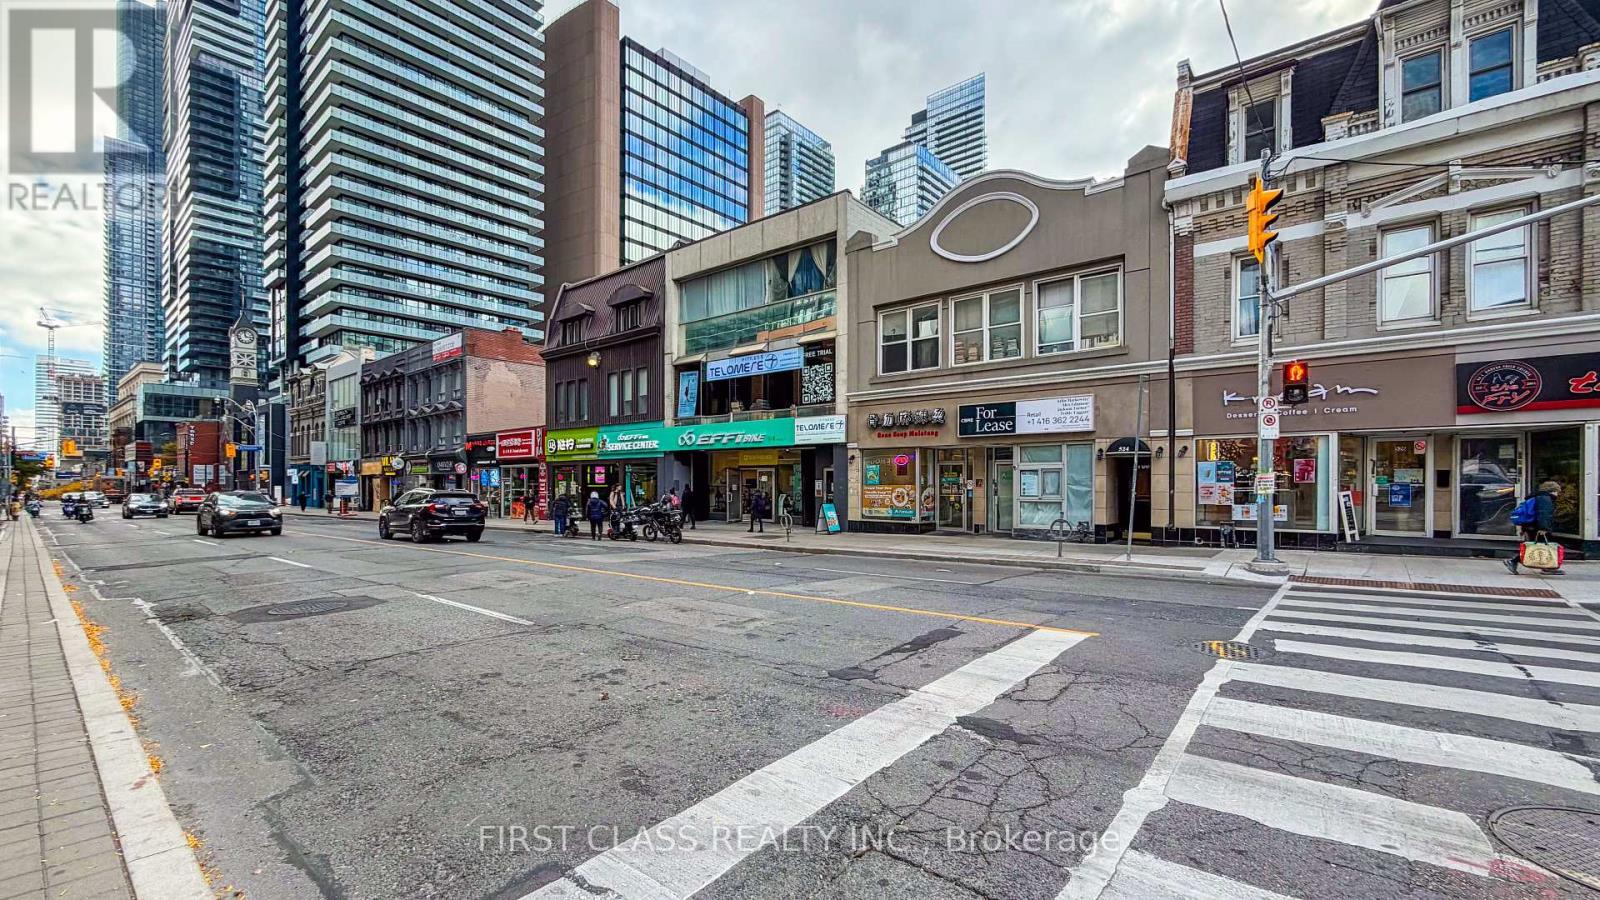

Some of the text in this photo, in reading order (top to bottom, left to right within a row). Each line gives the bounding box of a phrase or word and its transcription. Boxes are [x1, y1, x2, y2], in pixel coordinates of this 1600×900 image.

[976, 406, 997, 419] For
[1226, 411, 1260, 419] Desser
[1324, 406, 1358, 414] Cream
[975, 418, 1013, 432] Lease
[1036, 417, 1050, 425] 416
[1052, 416, 1067, 424] 362
[1069, 415, 1090, 423] 2244
